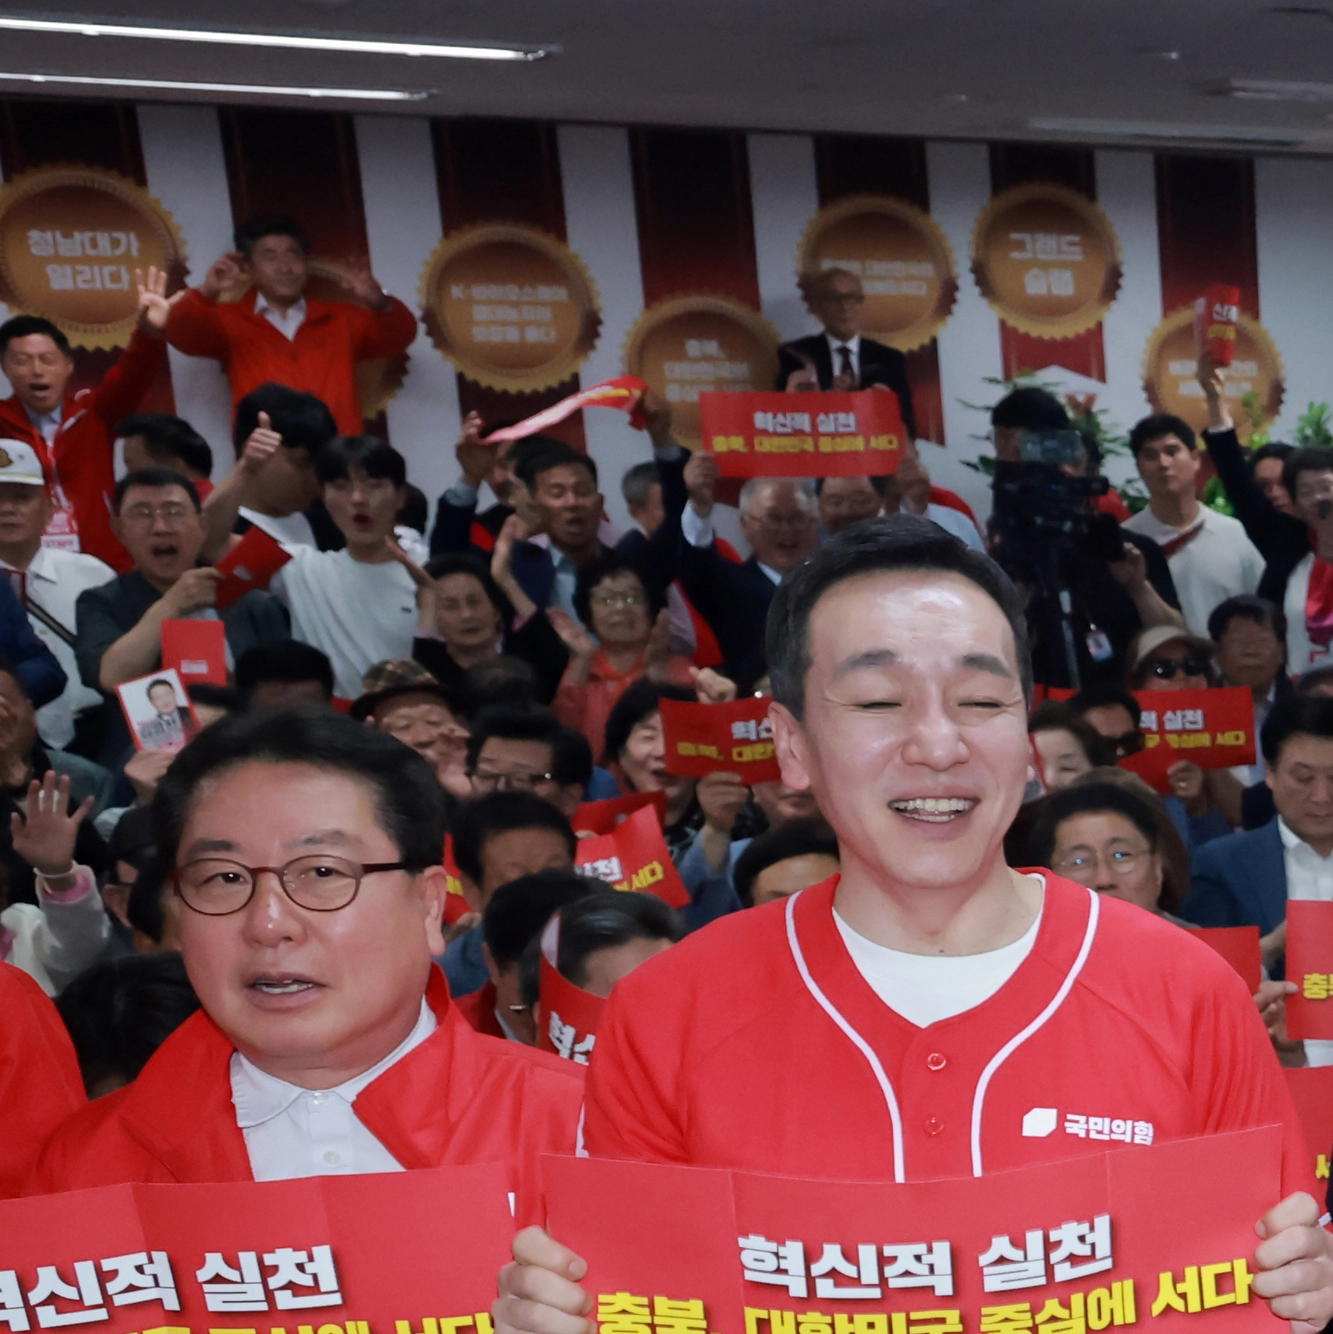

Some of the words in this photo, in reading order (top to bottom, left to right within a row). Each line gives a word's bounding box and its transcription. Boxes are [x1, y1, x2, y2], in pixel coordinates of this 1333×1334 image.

[1009, 232, 1085, 261] 그랜드
[1063, 1111, 1155, 1145] 국민의힘
[195, 1244, 345, 1315] 실천
[736, 1233, 956, 1299] 혁신적
[977, 1211, 1116, 1294] 실천
[1150, 1258, 1256, 1317] 서다
